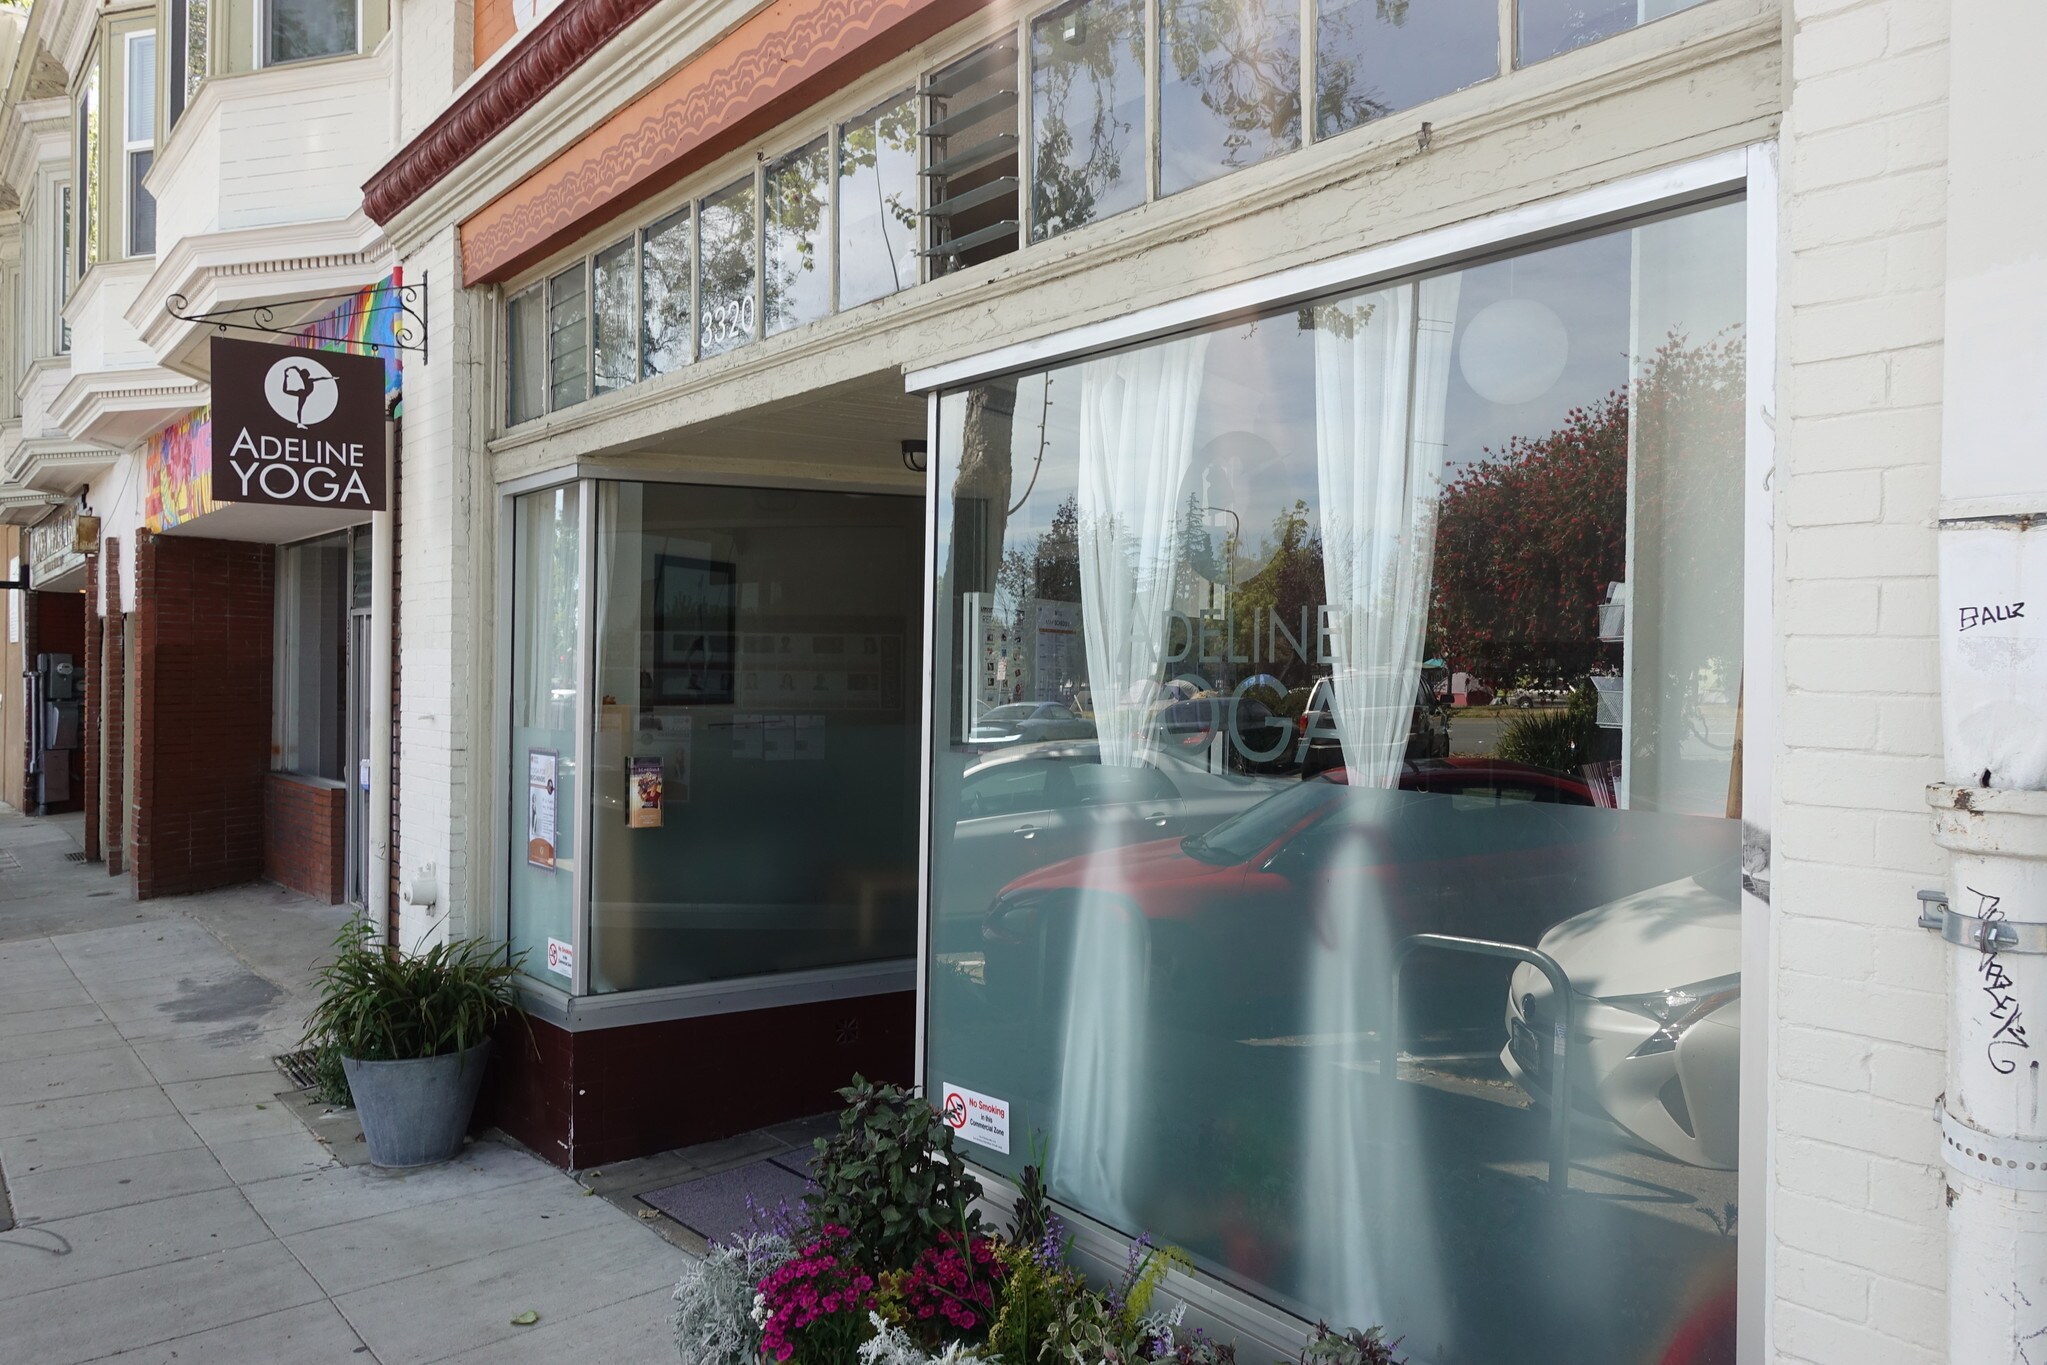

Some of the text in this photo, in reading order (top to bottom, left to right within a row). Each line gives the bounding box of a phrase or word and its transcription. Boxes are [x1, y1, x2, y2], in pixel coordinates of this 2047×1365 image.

[701, 295, 754, 348] 3320
[229, 426, 364, 467] ADELINE
[229, 460, 371, 504] YOGA
[1138, 672, 1358, 768] OGA
[969, 1098, 1004, 1118] No Smoking
[970, 1119, 1004, 1136] Commercial Zone
